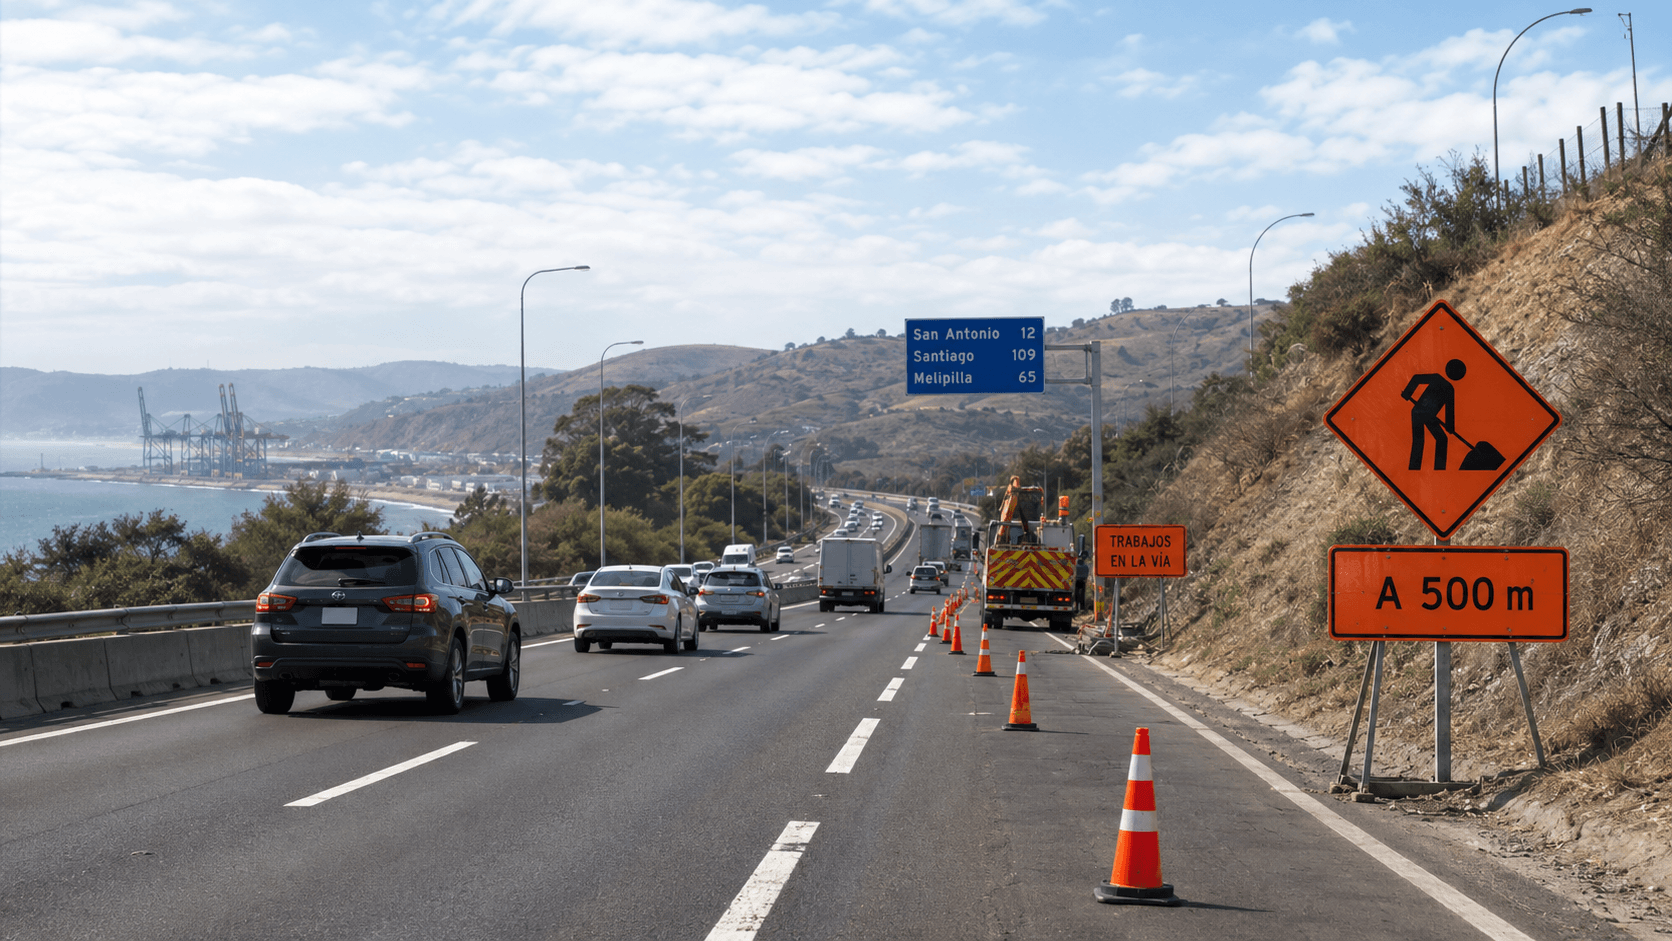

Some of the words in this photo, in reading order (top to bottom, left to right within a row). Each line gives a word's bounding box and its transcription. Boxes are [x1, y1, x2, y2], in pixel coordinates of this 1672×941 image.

[913, 328, 939, 341] San
[945, 327, 1000, 340] Antonio
[1020, 327, 1036, 339] 12
[913, 350, 975, 365] Santiago
[1012, 349, 1036, 361] 109
[914, 371, 972, 387] Melipilla
[1018, 371, 1036, 383] 65
[1109, 535, 1172, 548] TRABAJOS
[1110, 555, 1126, 568] EN
[1131, 555, 1147, 568] LA
[1375, 576, 1403, 610] A
[1421, 576, 1495, 611] 500
[1506, 585, 1534, 610] m
